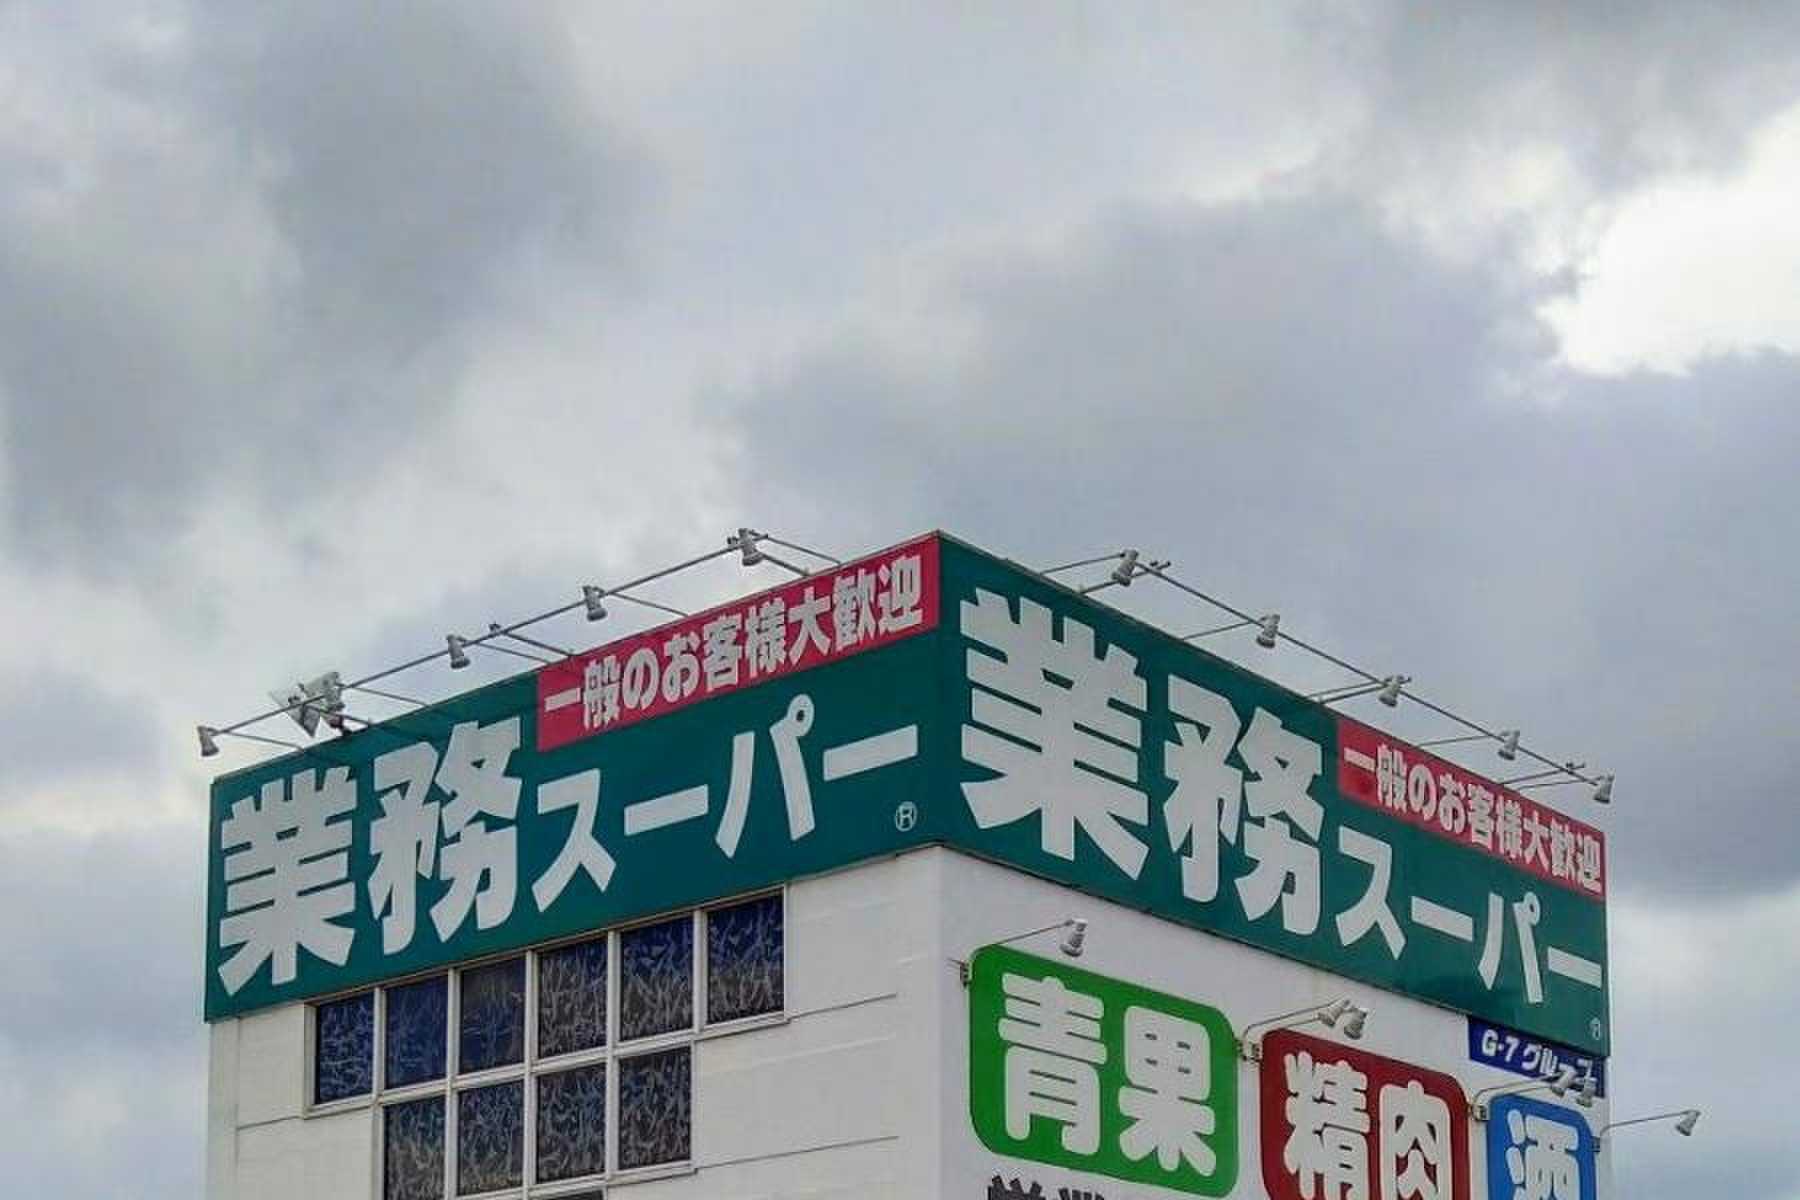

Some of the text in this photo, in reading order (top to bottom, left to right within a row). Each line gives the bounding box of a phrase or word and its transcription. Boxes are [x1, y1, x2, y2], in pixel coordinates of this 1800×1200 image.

[544, 555, 922, 730] 一般のお客様大歓迎
[218, 694, 919, 995] 業務スーパー
[960, 587, 1601, 1005] 業務スーパー
[1343, 743, 1600, 889] 一般のお客様大歓迎
[998, 975, 1218, 1177] 青果
